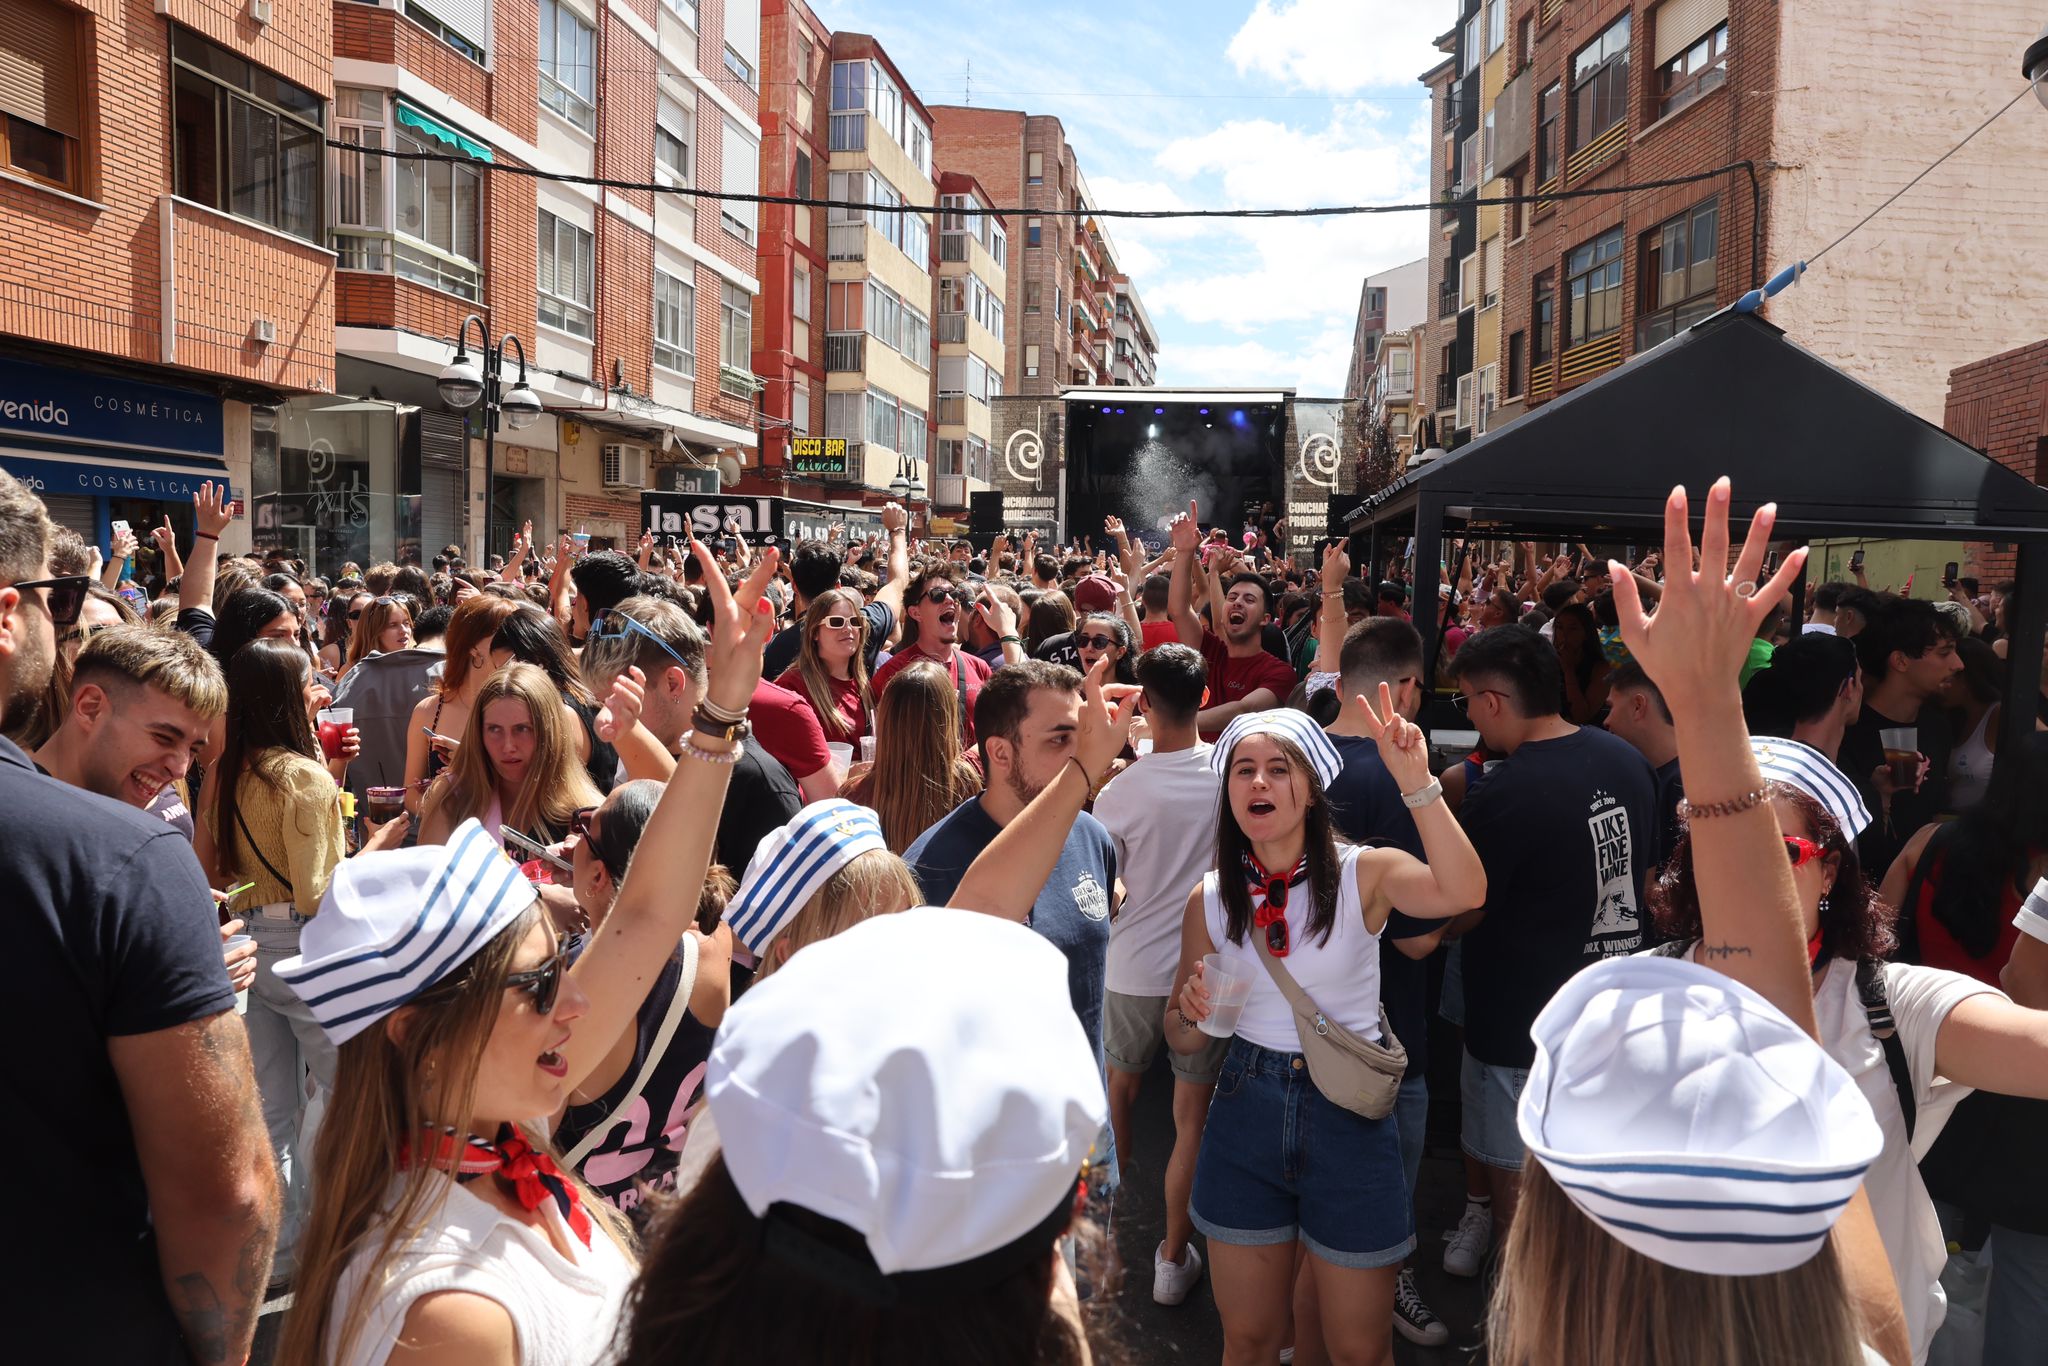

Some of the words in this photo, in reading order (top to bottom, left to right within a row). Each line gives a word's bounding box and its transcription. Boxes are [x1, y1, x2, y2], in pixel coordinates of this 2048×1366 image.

[94, 395, 203, 424] COSMÉTICA
[793, 438, 821, 456] DISCO
[825, 439, 845, 456] BAR
[16, 474, 45, 490] nida
[78, 473, 190, 495] COSMÉTICA
[675, 477, 702, 492] sal
[1003, 496, 1055, 508] NCHABANDO
[650, 504, 682, 533] la
[691, 499, 773, 533] sal
[1003, 509, 1055, 521] ODUCCIONES
[1292, 534, 1309, 546] 647
[1590, 799, 1603, 812] SINCE
[1602, 797, 1616, 805] 2009
[1593, 812, 1627, 845] LIKE
[1598, 836, 1629, 869] FINE
[1600, 859, 1629, 887] WINE
